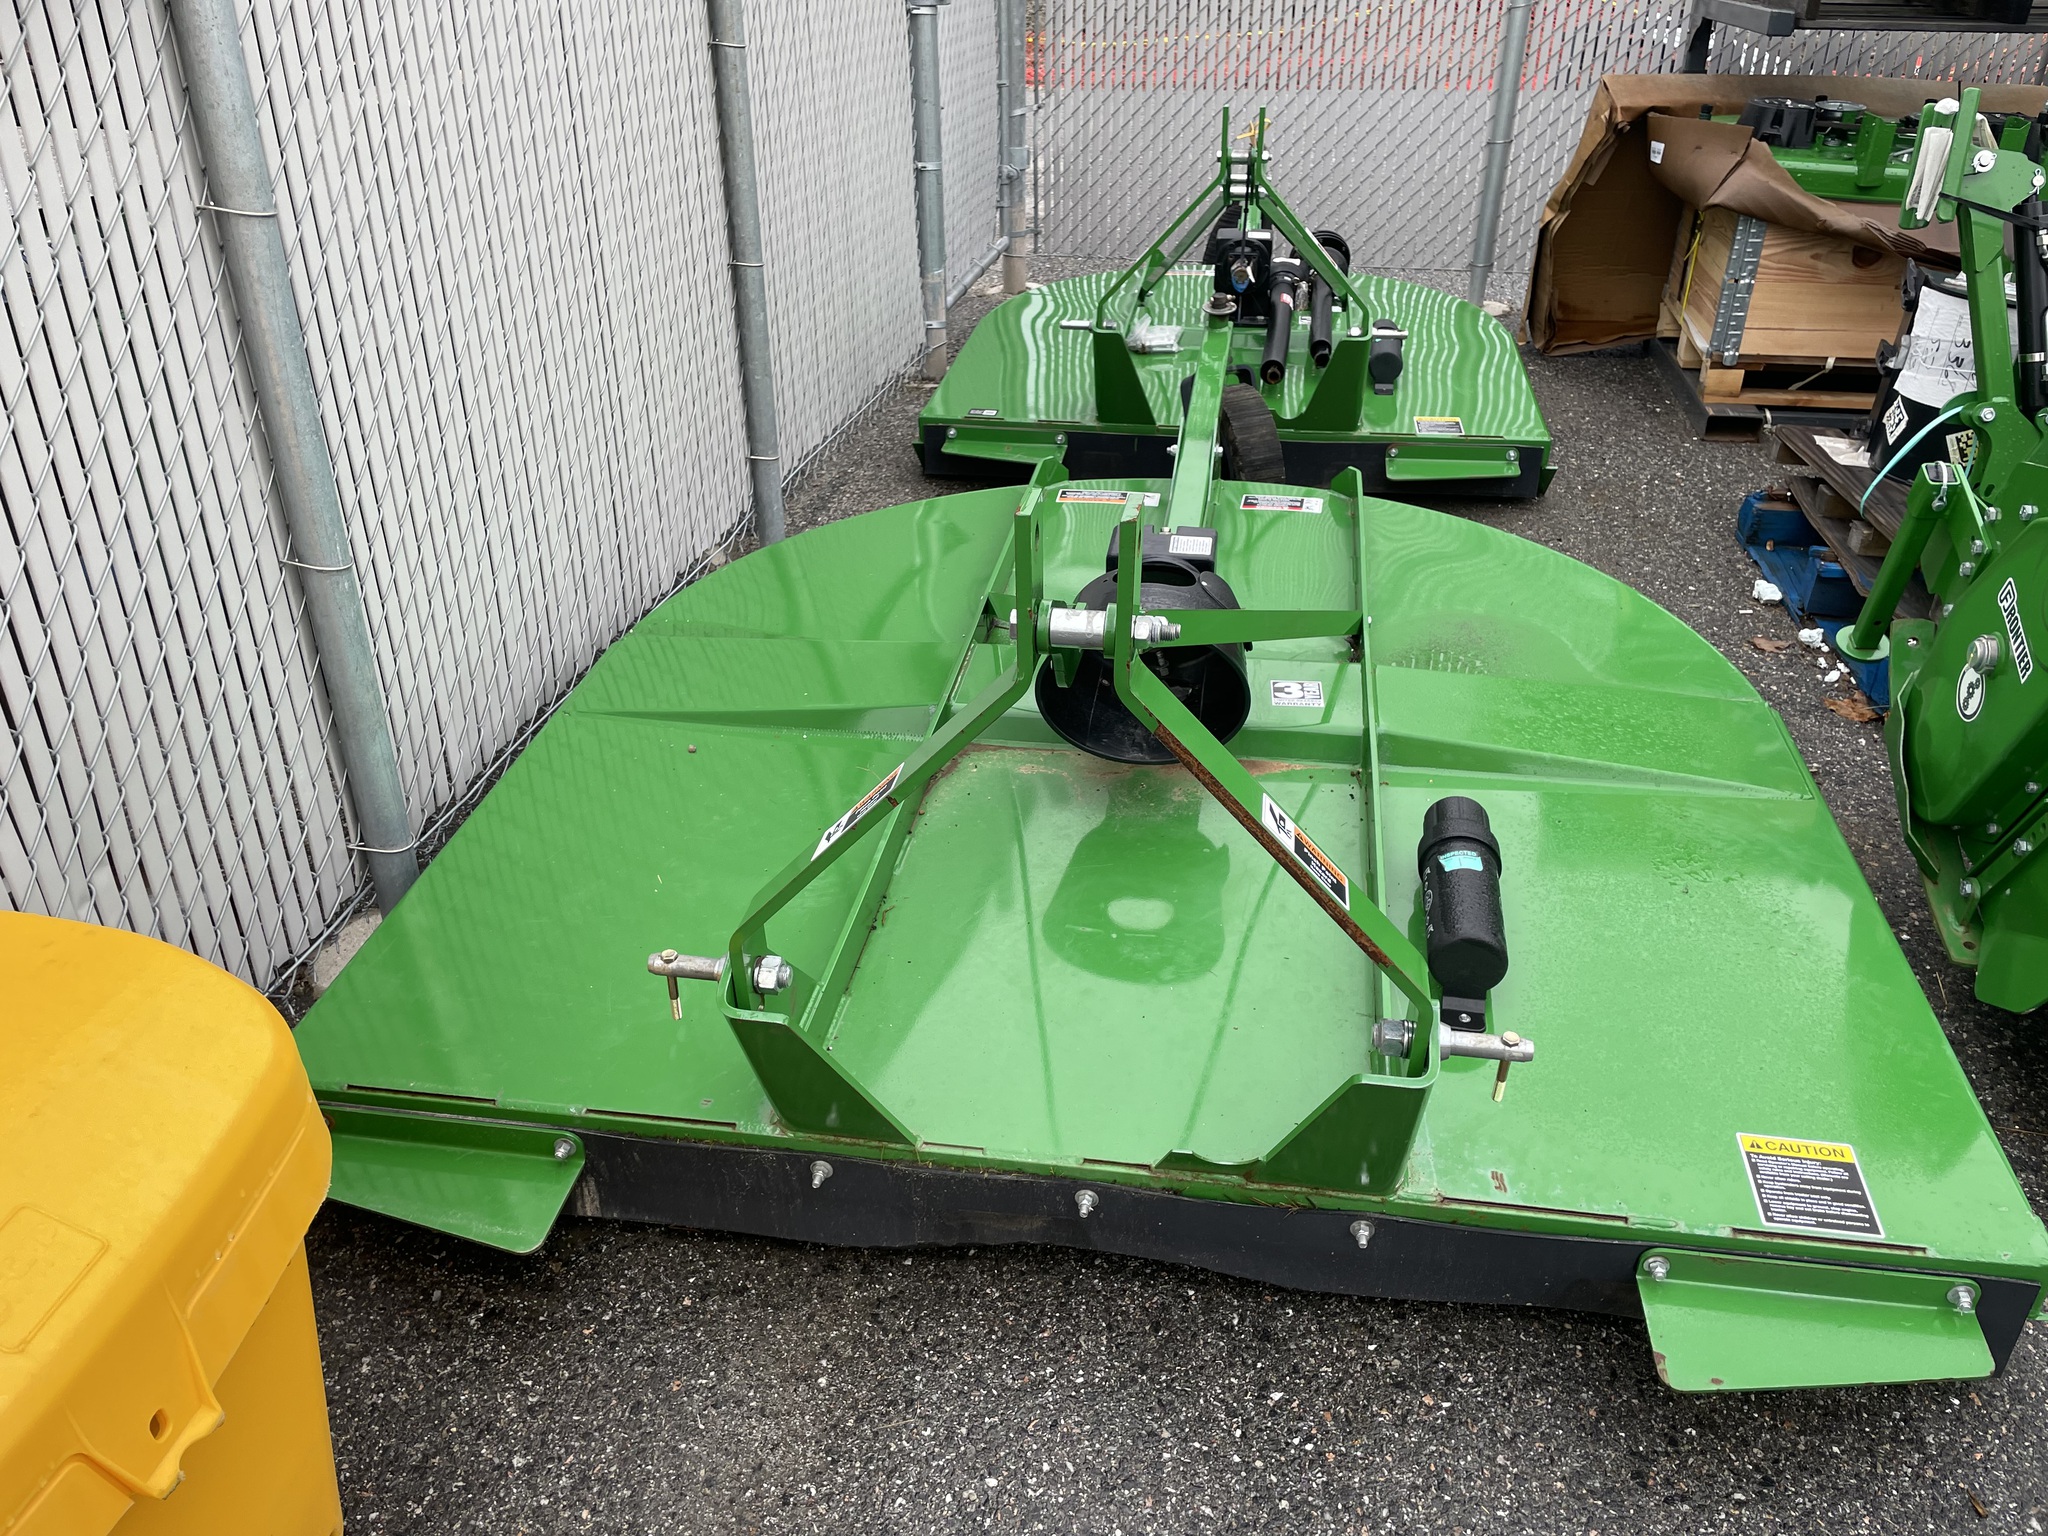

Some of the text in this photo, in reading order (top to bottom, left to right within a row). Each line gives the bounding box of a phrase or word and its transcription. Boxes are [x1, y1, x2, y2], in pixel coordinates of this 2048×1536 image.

[1999, 580, 2031, 680] FRONTIER
[1440, 850, 1476, 859] INSPECTED
[1765, 1141, 1845, 1158] CAUTION
